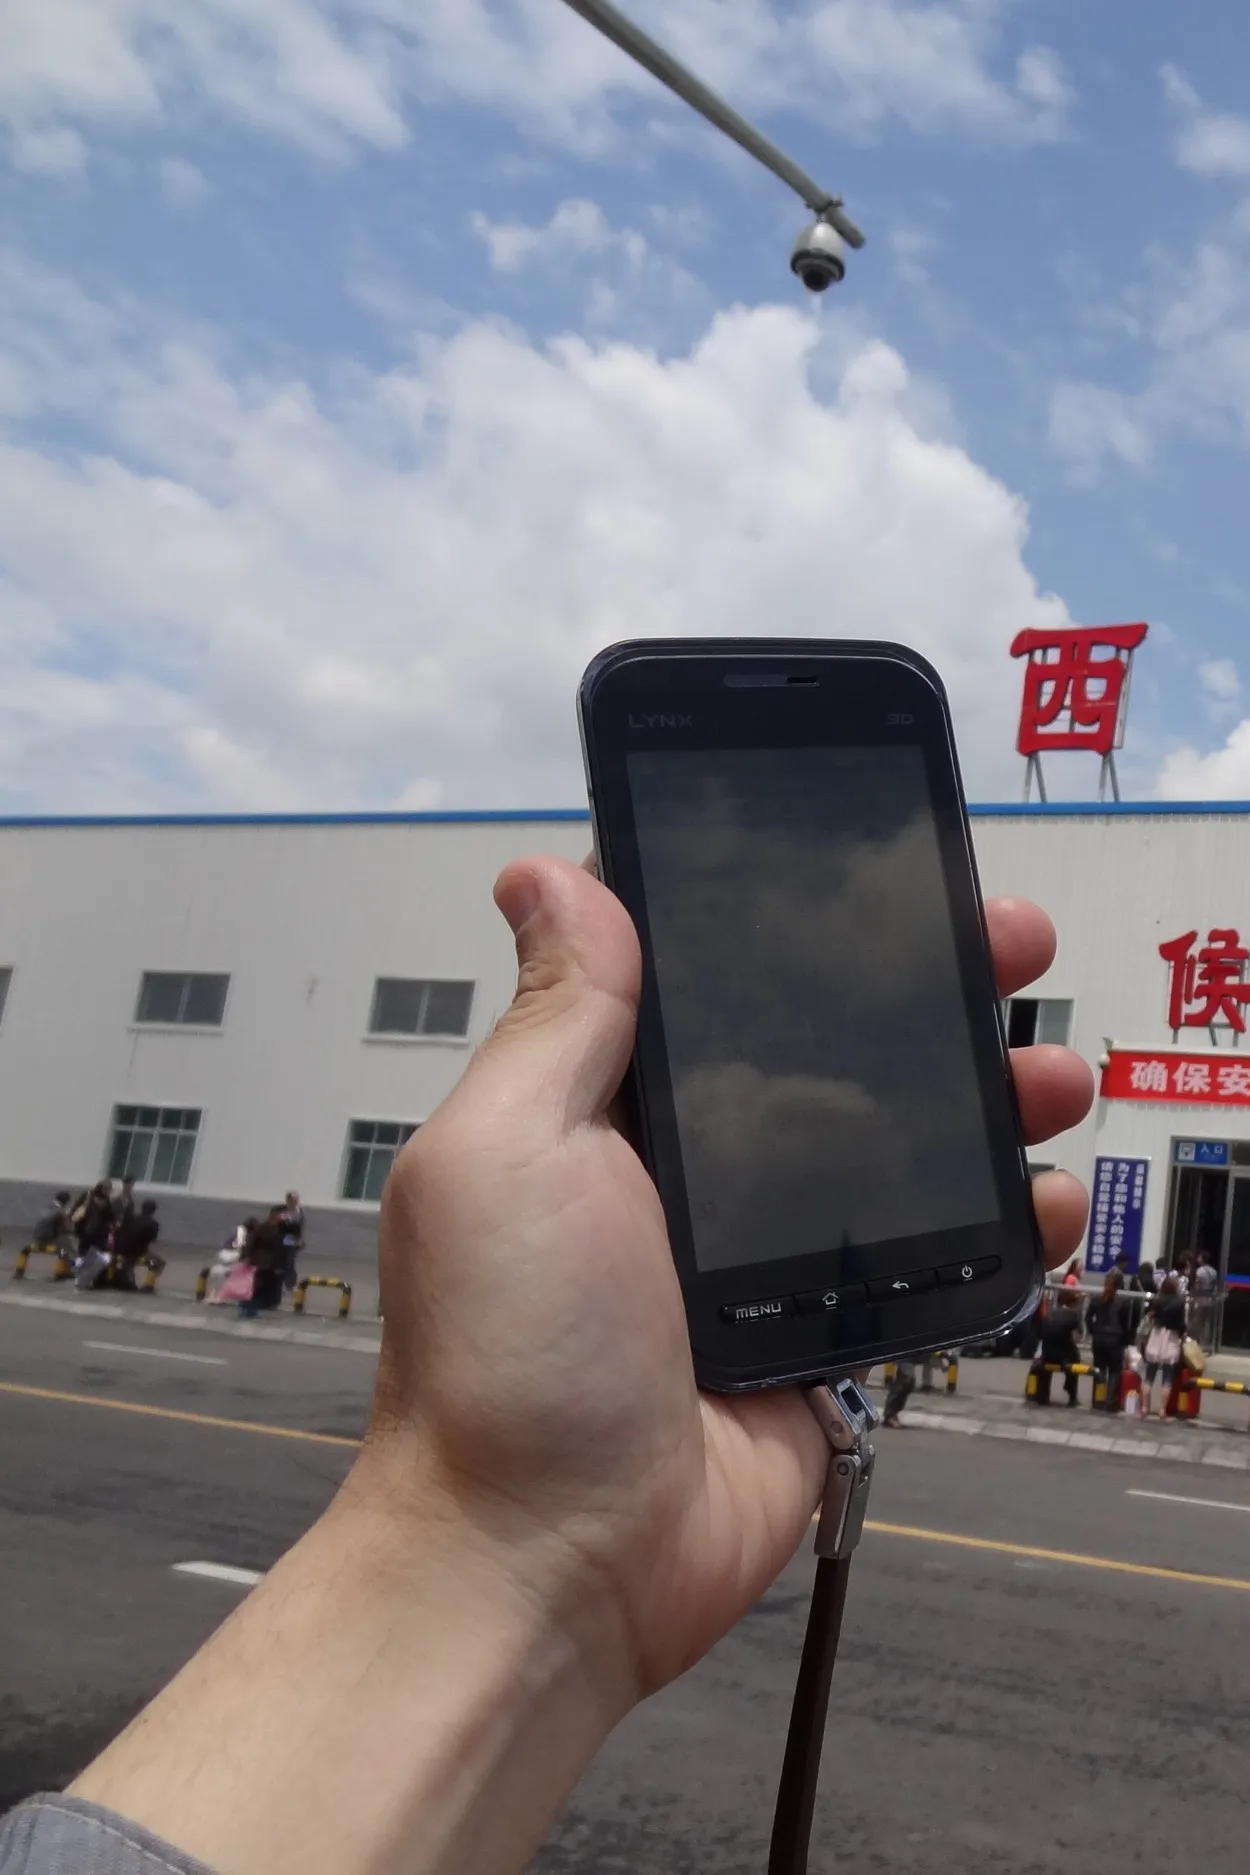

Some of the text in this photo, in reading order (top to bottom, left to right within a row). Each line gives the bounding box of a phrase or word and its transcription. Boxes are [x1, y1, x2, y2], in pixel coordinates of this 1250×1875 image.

[628, 713, 914, 728] LYNX 3D
[735, 1302, 782, 1320] MENU
